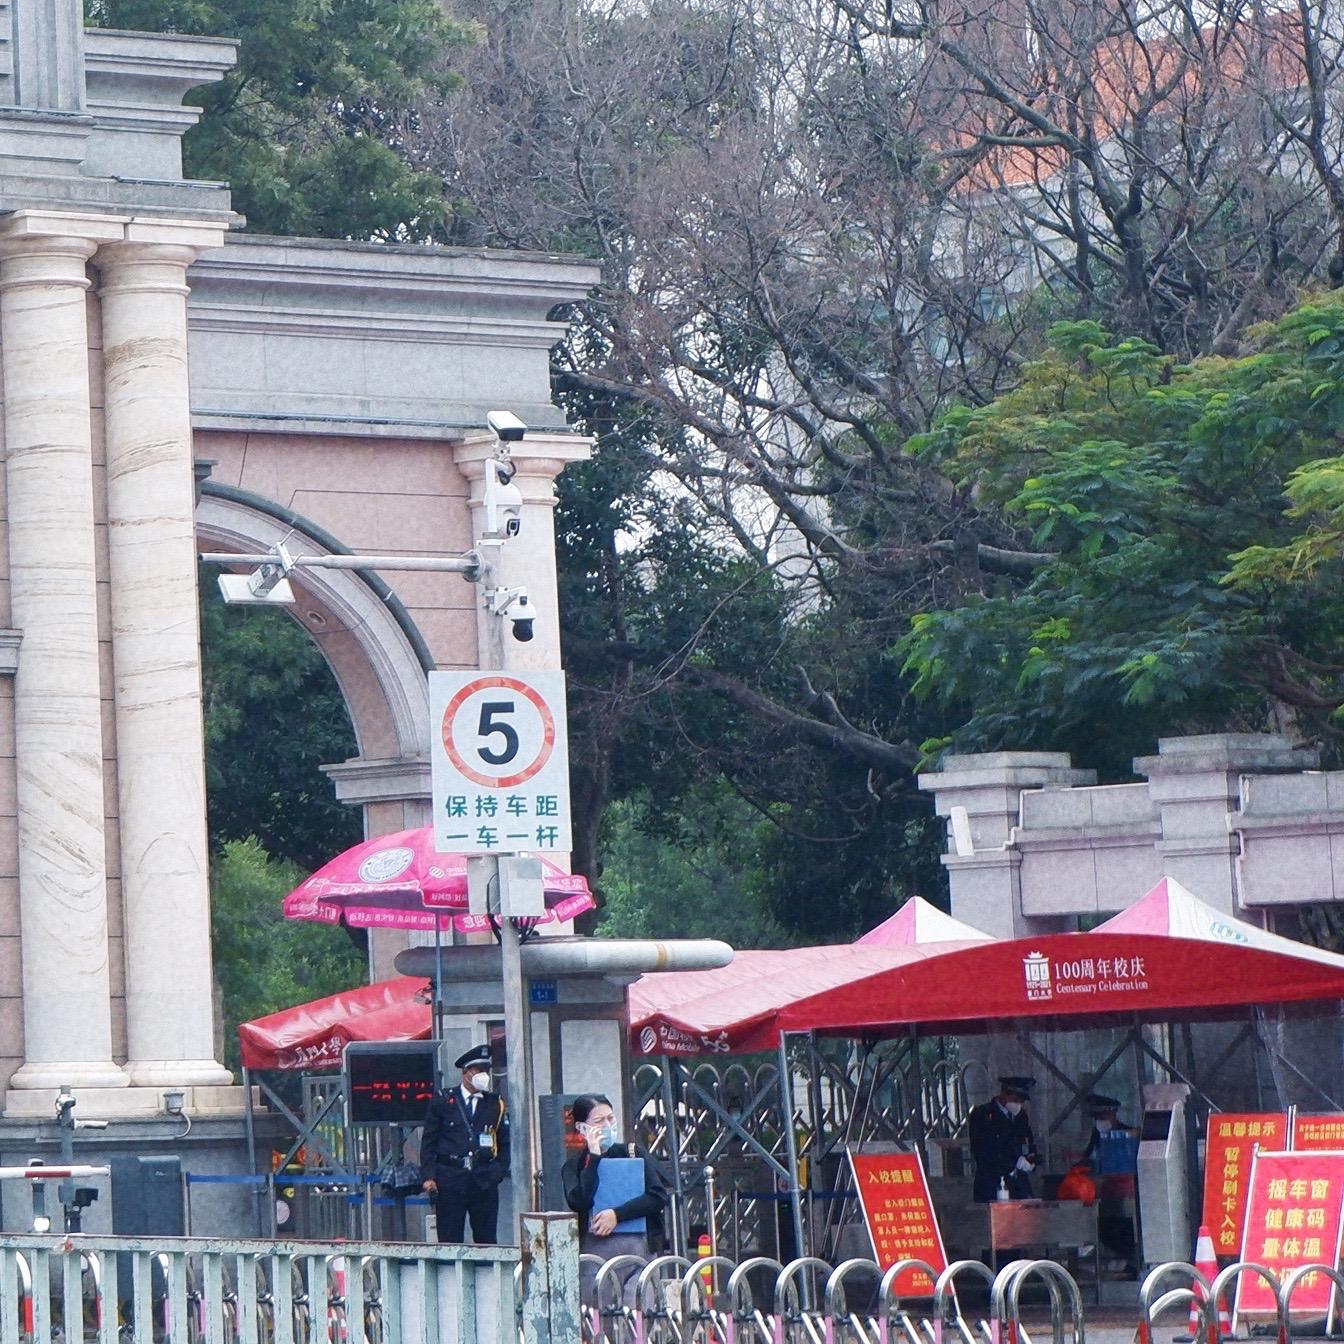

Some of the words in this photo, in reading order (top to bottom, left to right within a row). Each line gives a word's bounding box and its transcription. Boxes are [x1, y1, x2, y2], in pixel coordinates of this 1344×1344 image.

[477, 702, 519, 765] 5
[445, 794, 558, 818] 保持车距
[446, 825, 559, 848] 一车一杆
[1055, 956, 1146, 979] 100周年校庆
[1056, 983, 1097, 994] Centenary
[1098, 979, 1149, 991] Celebration
[1219, 1122, 1276, 1137] 温馨提示
[869, 1169, 914, 1184] 入校提醒
[1268, 1179, 1329, 1200] 摇车窗
[1265, 1208, 1325, 1229] 健康码
[1262, 1238, 1321, 1259] 量体温
